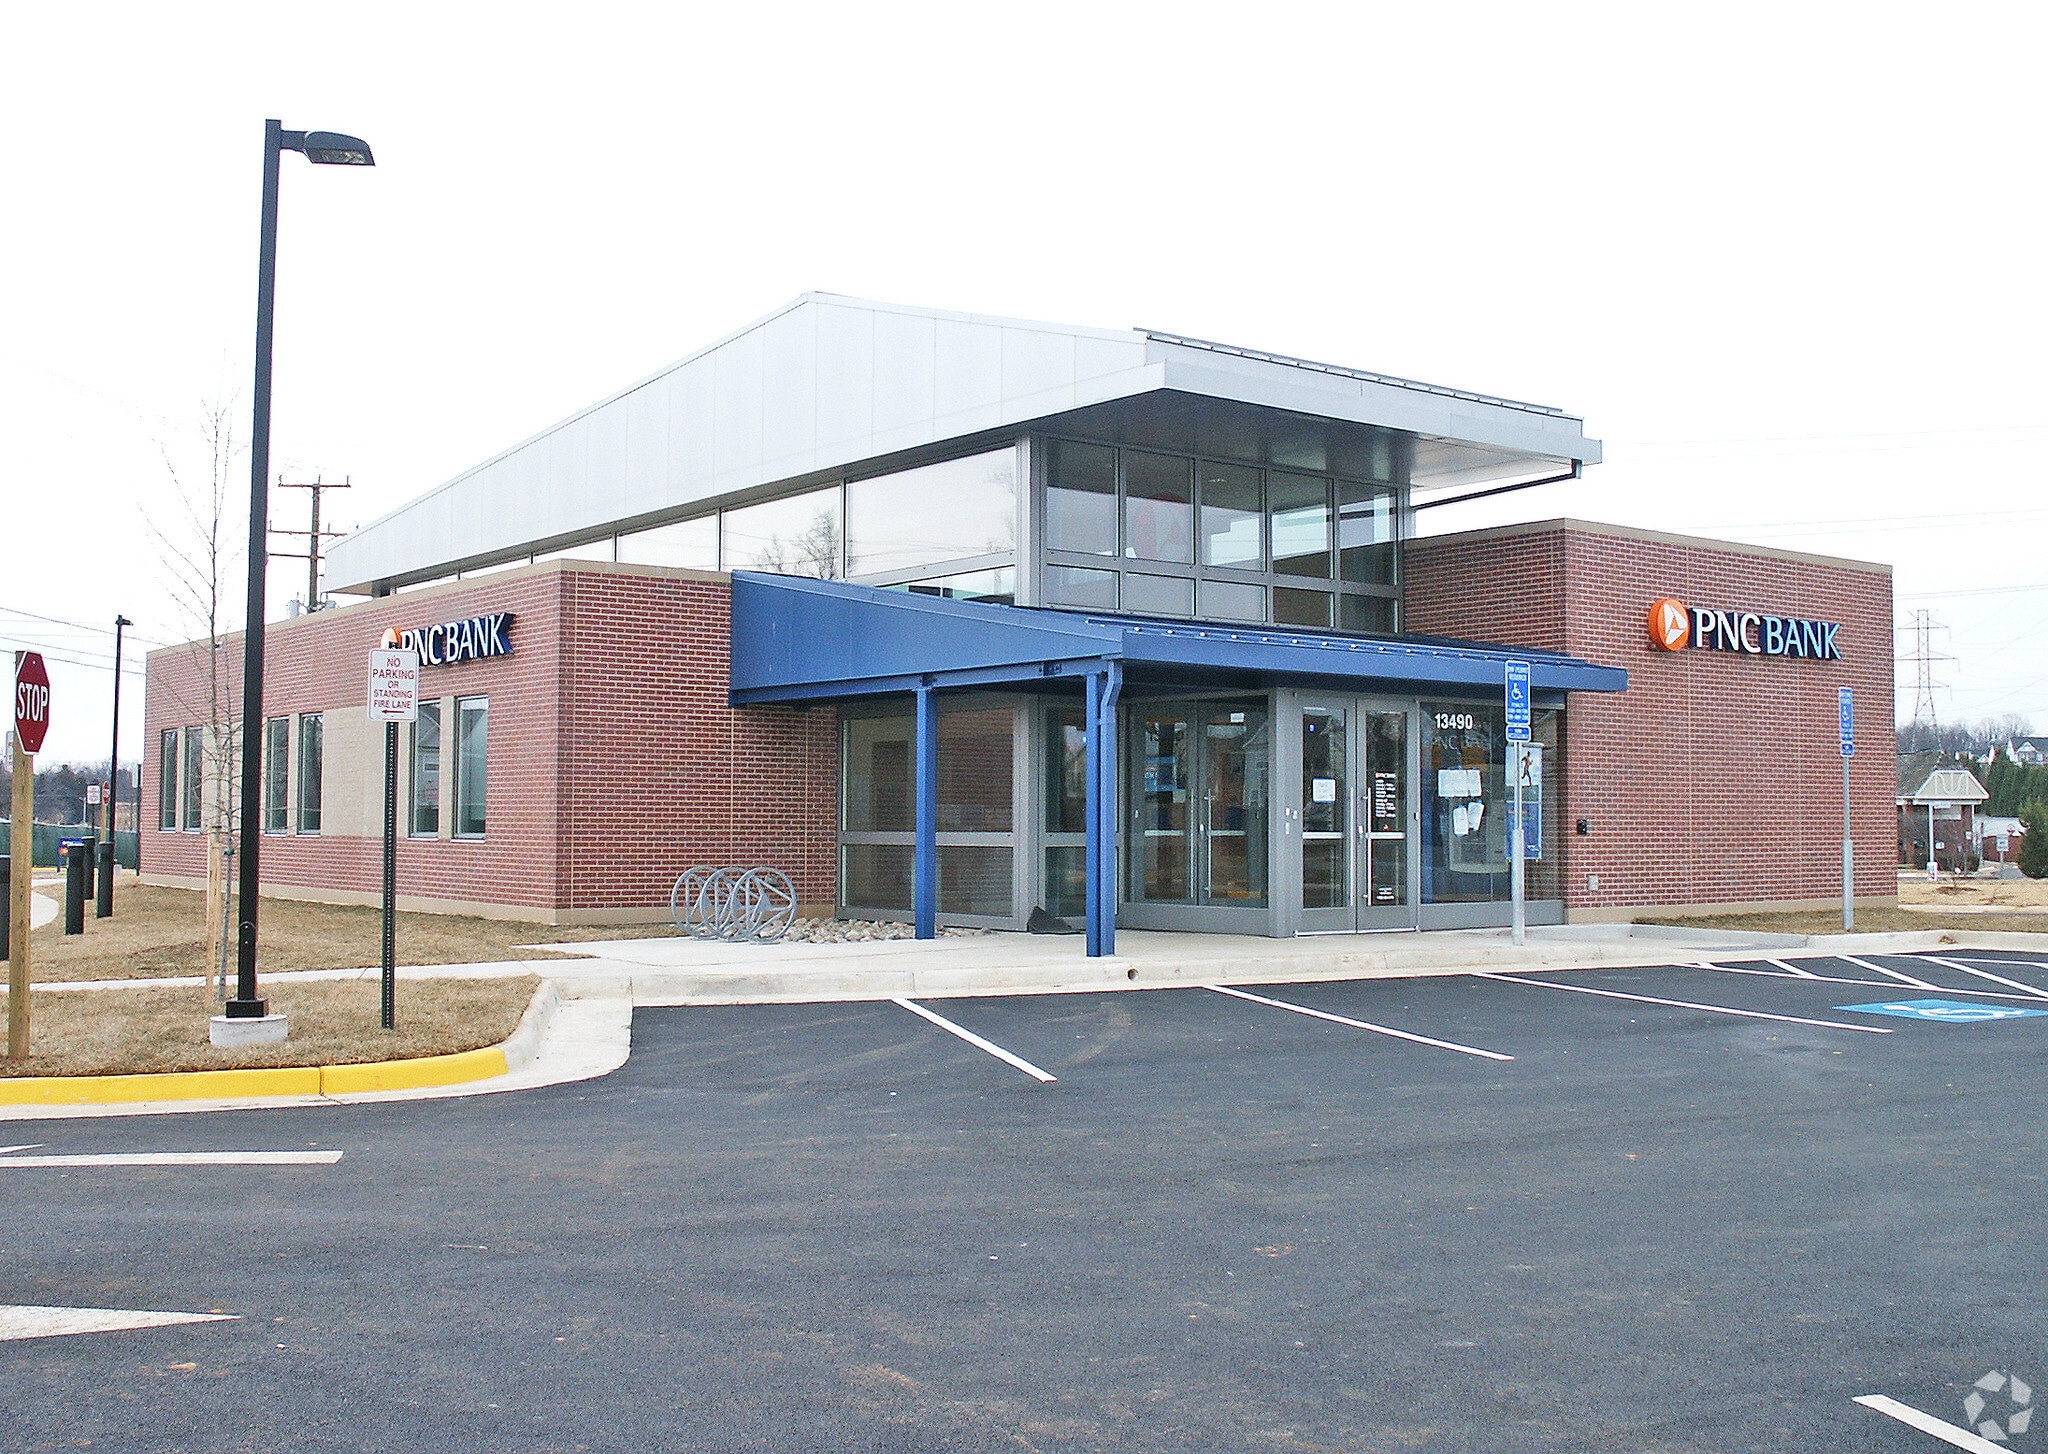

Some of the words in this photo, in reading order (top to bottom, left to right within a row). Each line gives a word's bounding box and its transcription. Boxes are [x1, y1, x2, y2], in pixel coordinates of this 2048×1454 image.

[444, 612, 507, 663] BANK
[1691, 607, 1762, 654] PNC
[1762, 615, 1842, 661] BANK
[386, 657, 401, 668] NO
[372, 668, 415, 680] PARKING
[387, 680, 399, 689] OR
[373, 689, 413, 699] STANDING
[17, 681, 48, 722] STOP
[373, 699, 390, 708] FIRE
[392, 700, 411, 709] LANE
[1434, 713, 1473, 730] 13490
